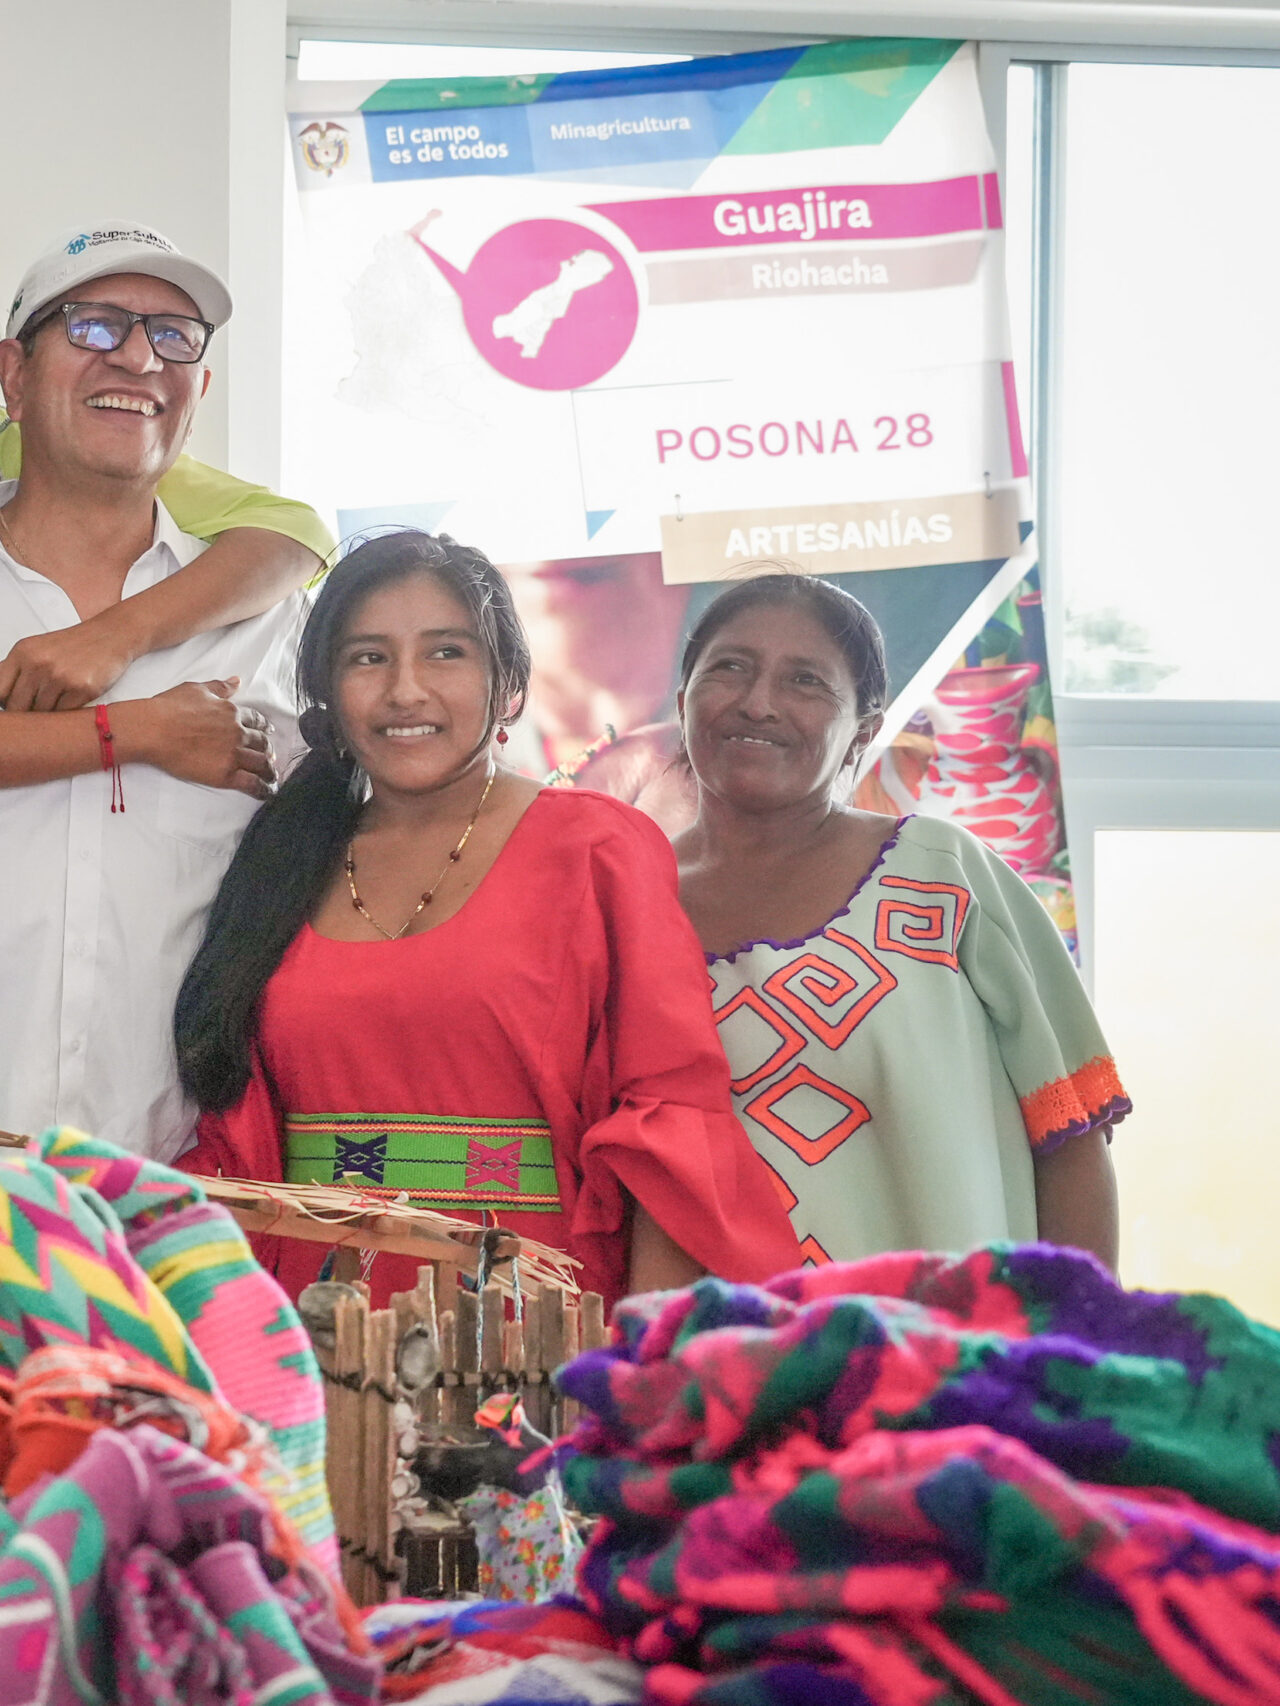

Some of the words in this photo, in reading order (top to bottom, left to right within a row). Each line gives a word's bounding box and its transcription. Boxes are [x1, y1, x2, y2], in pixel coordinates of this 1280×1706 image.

[386, 126, 406, 146] El
[410, 124, 480, 147] campo
[550, 115, 692, 142] Minagricultura
[388, 148, 414, 165] es
[418, 143, 444, 164] de
[448, 140, 509, 162] todos
[713, 191, 873, 241] Guajira
[751, 257, 889, 289] Riohacha
[656, 418, 859, 465] POSONA
[873, 412, 935, 452] 28
[724, 510, 953, 558] ARTESANÍAS
